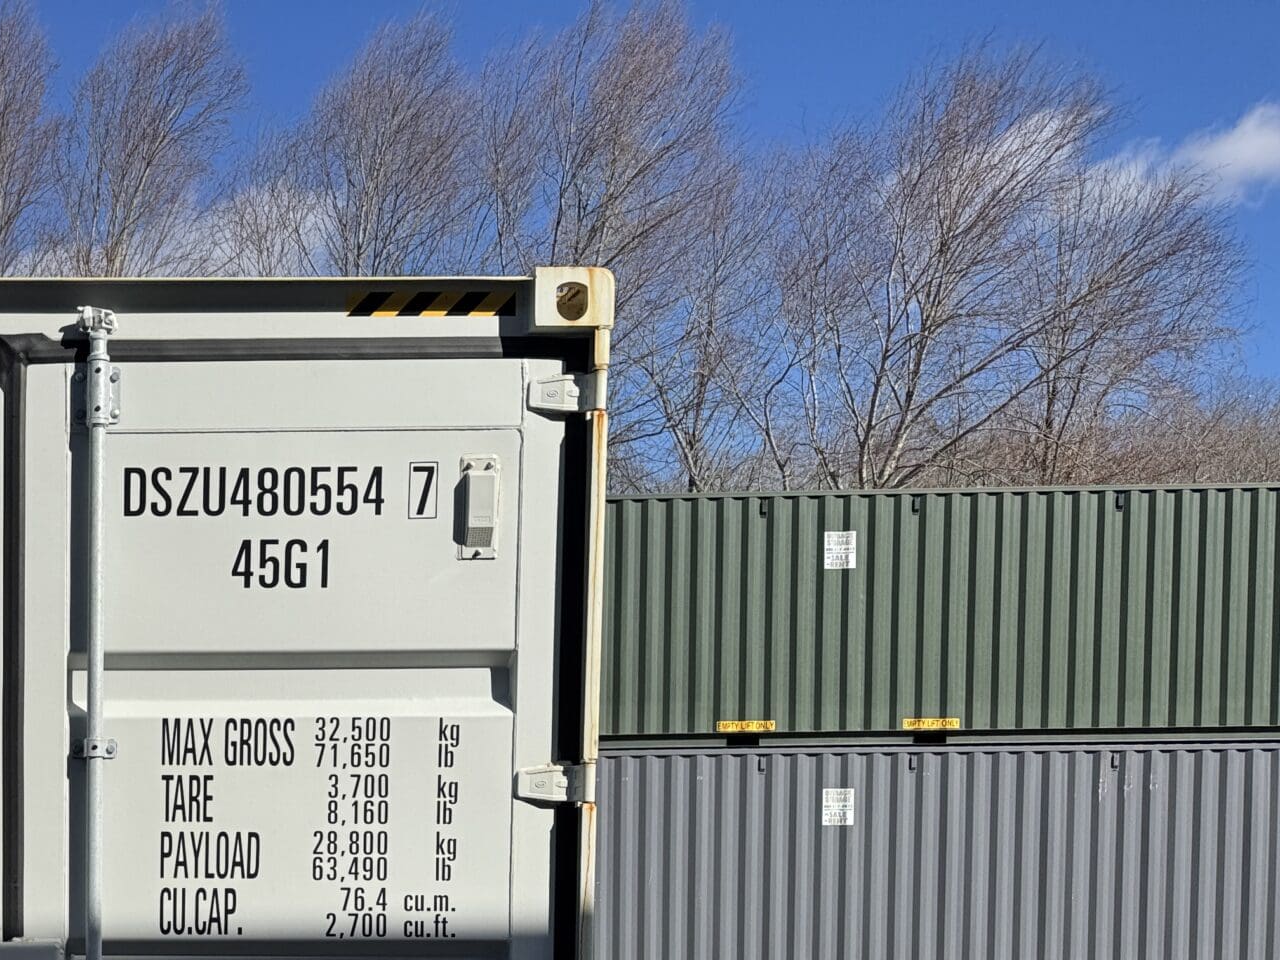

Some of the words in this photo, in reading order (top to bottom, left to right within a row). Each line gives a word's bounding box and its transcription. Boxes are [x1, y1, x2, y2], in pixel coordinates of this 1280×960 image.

[123, 466, 385, 517] DSZU480554
[412, 465, 436, 516] 7
[231, 539, 331, 589] 45G1
[161, 717, 213, 766] MAX
[224, 717, 296, 767] GROSS
[314, 716, 391, 743] 32,500
[438, 721, 460, 747] kg
[740, 722, 755, 730] LIFT
[756, 721, 774, 729] ONLY
[314, 743, 391, 769] 71,650
[438, 743, 454, 768] lb
[161, 774, 214, 823] TARE
[327, 774, 389, 800] 3,700
[437, 778, 459, 804] kg
[327, 800, 389, 826] 8,160
[436, 800, 453, 825] lb
[160, 831, 261, 880] PAYLOAD
[312, 831, 389, 857] 28,800
[436, 835, 458, 861] kg
[312, 857, 389, 882] 63,490
[435, 857, 452, 882] lb
[160, 887, 243, 936] CU.CAP.
[340, 887, 389, 912] 76.4
[404, 892, 456, 912] cu.m.
[325, 913, 388, 939] 2,700
[404, 916, 456, 938] cu.ft.
